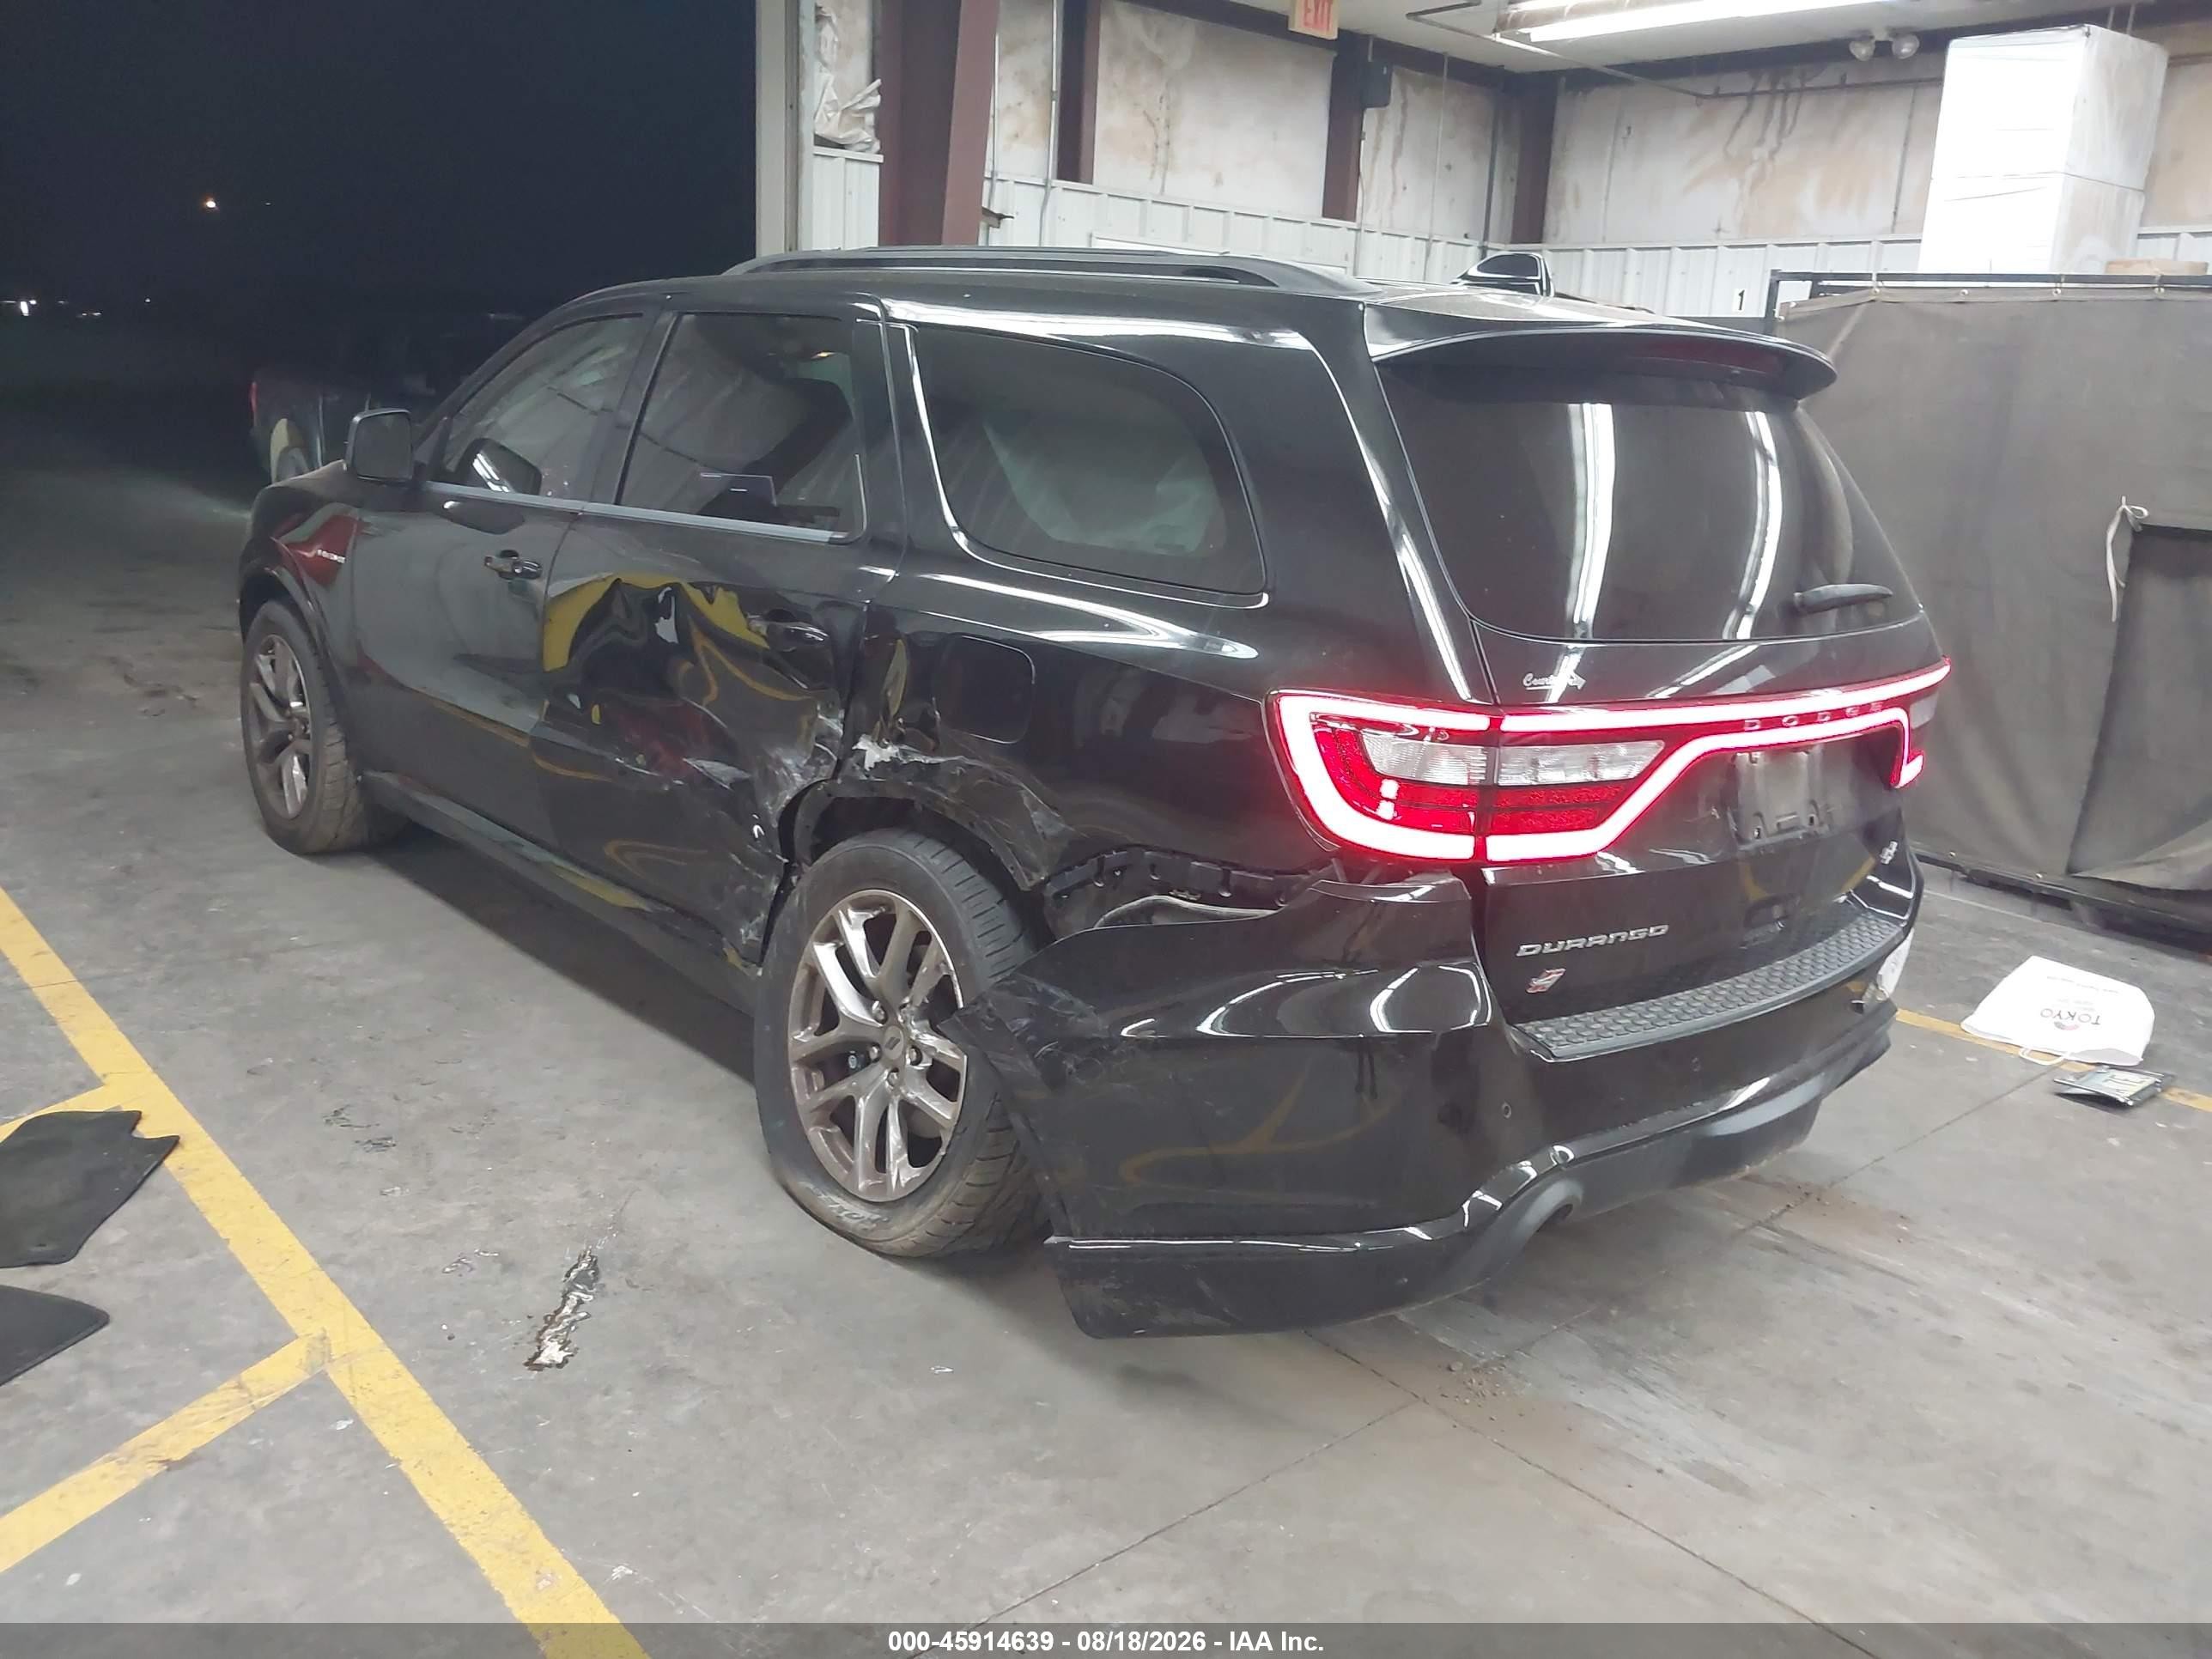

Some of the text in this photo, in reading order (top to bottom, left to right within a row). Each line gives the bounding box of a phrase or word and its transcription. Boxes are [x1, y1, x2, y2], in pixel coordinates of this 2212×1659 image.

[1303, 0, 1333, 31] EXIT
[1738, 289, 1745, 311] 1
[1743, 701, 1884, 731] DODGE
[1516, 924, 1669, 957] DURANGO
[2039, 1007, 2101, 1026] TOKYO
